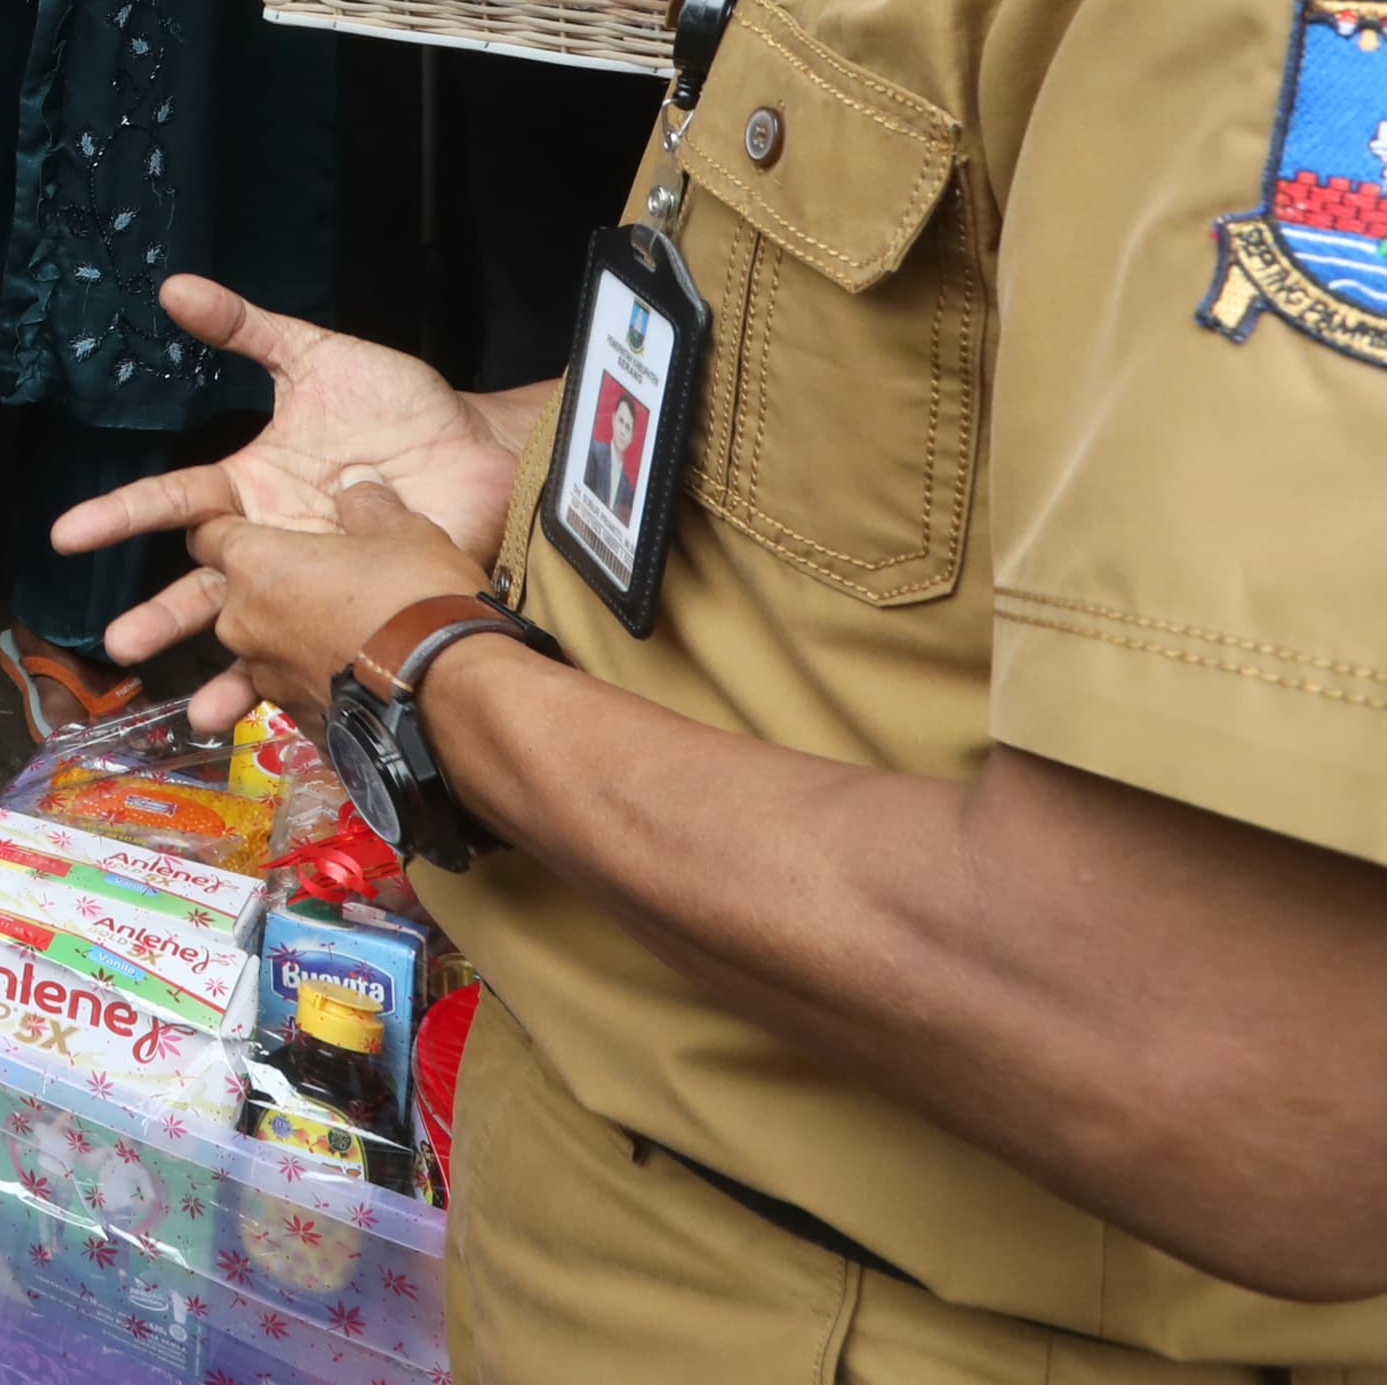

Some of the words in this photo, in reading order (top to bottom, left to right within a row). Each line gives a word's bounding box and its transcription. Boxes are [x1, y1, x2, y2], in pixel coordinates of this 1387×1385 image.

[109, 852, 209, 887] Anlene
[92, 916, 199, 964] Anlene
[13, 1012, 83, 1055] 5X
